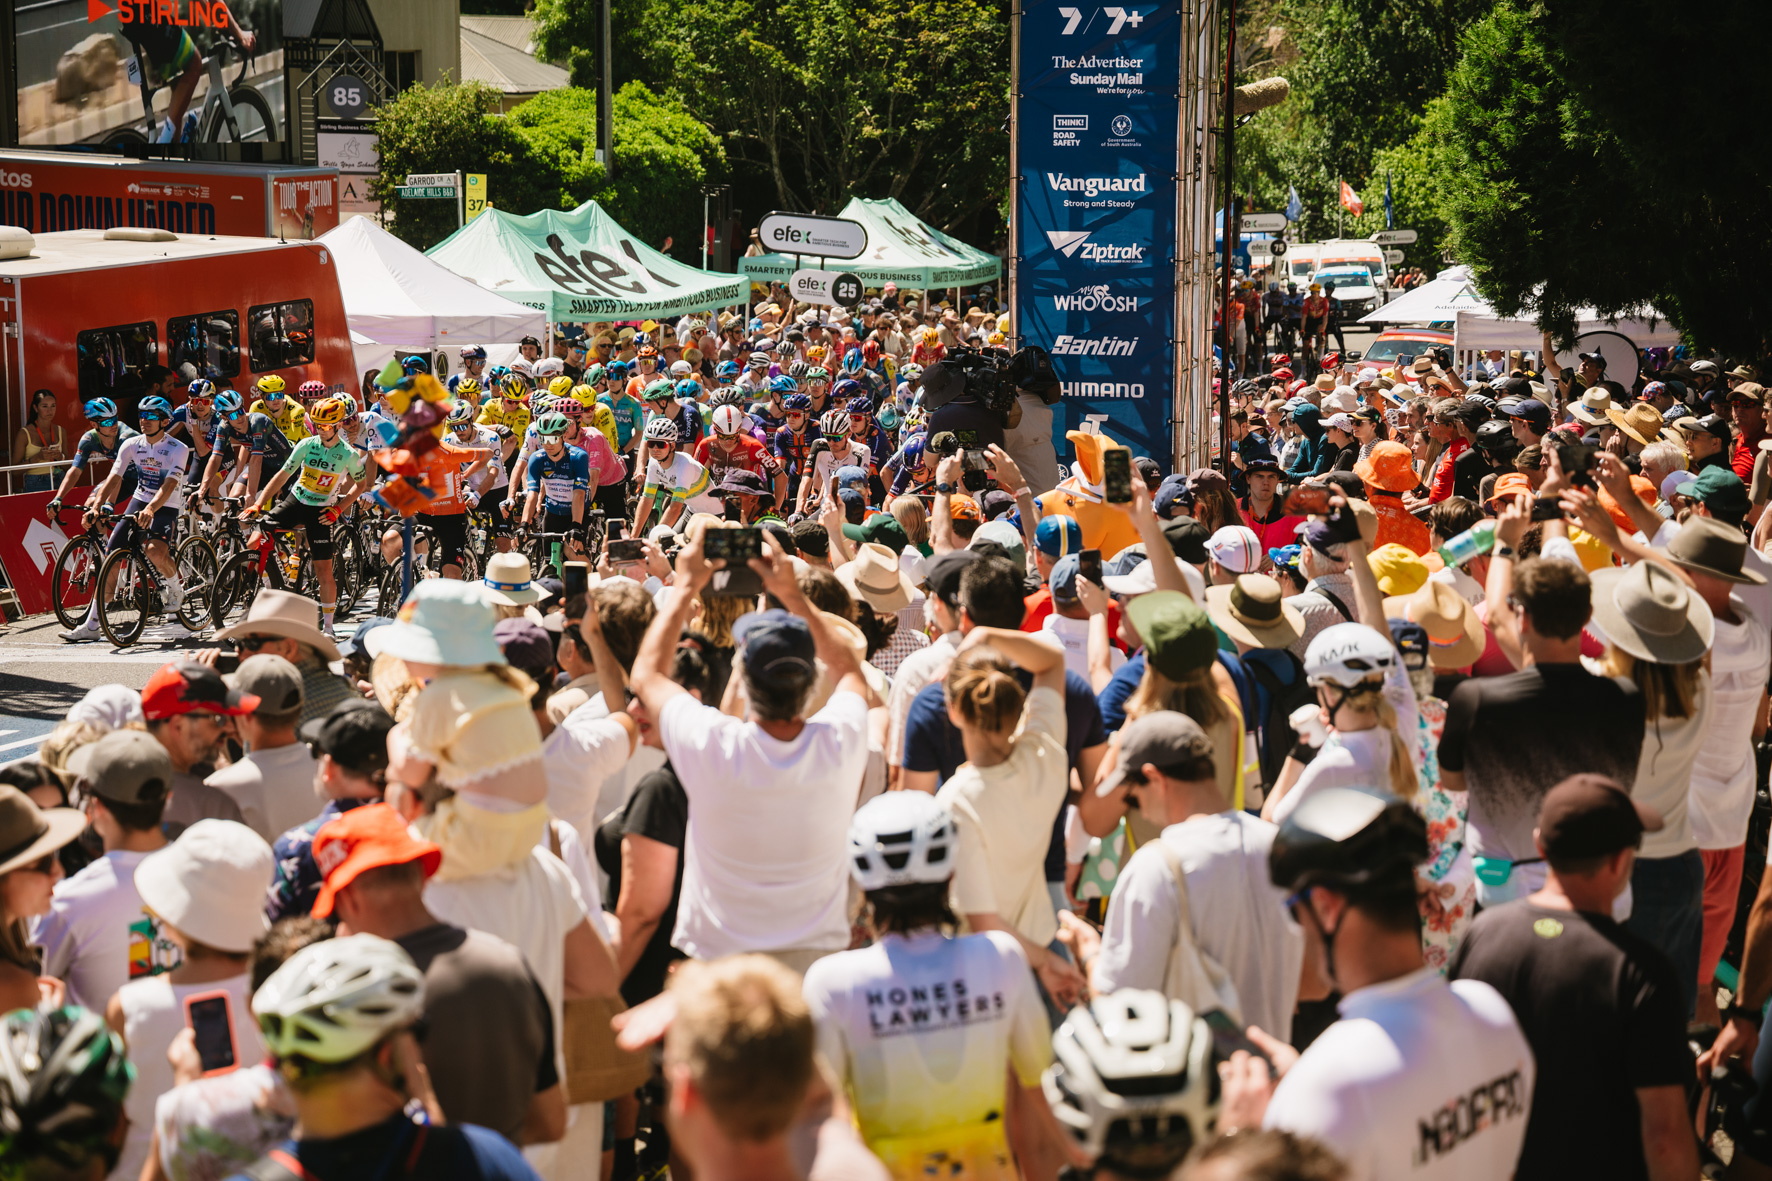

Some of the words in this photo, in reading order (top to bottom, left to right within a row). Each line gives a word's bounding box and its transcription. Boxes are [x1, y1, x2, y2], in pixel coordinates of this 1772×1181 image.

[118, 0, 228, 28] STIRLING
[1052, 56, 1076, 68] The
[1077, 56, 1144, 68] Advertiser
[1070, 73, 1116, 87] Sunday
[1117, 73, 1143, 84] Mail
[334, 87, 361, 106] 85
[1126, 88, 1146, 98] you
[409, 177, 436, 186] GARROD
[1047, 172, 1146, 197] Vanguard
[279, 182, 296, 210] TOUR
[310, 180, 332, 207] ACTION
[402, 187, 425, 197] ADELAIDE
[426, 186, 442, 196] HILLS
[443, 186, 454, 196] B&B
[468, 199, 484, 211] 37
[1064, 200, 1090, 208] Strong
[1108, 200, 1135, 208] Steady
[773, 225, 812, 244] efex
[1080, 243, 1143, 262] Ziptrak
[744, 266, 784, 275] SMARTER
[880, 273, 922, 282] BUSINESS
[798, 277, 826, 291] efex
[838, 282, 856, 298] 25
[569, 300, 617, 314] SMARTER
[704, 284, 740, 303] BUSINESS
[1054, 295, 1137, 312] WHOOSH
[1051, 335, 1139, 356] Santini
[1060, 382, 1144, 398] HIMANO
[309, 458, 336, 472] efex
[754, 448, 776, 468] lotto
[305, 472, 318, 480] Uno
[454, 473, 462, 504] Santos
[866, 979, 968, 1006] HONES
[870, 992, 1004, 1031] LAWYERS
